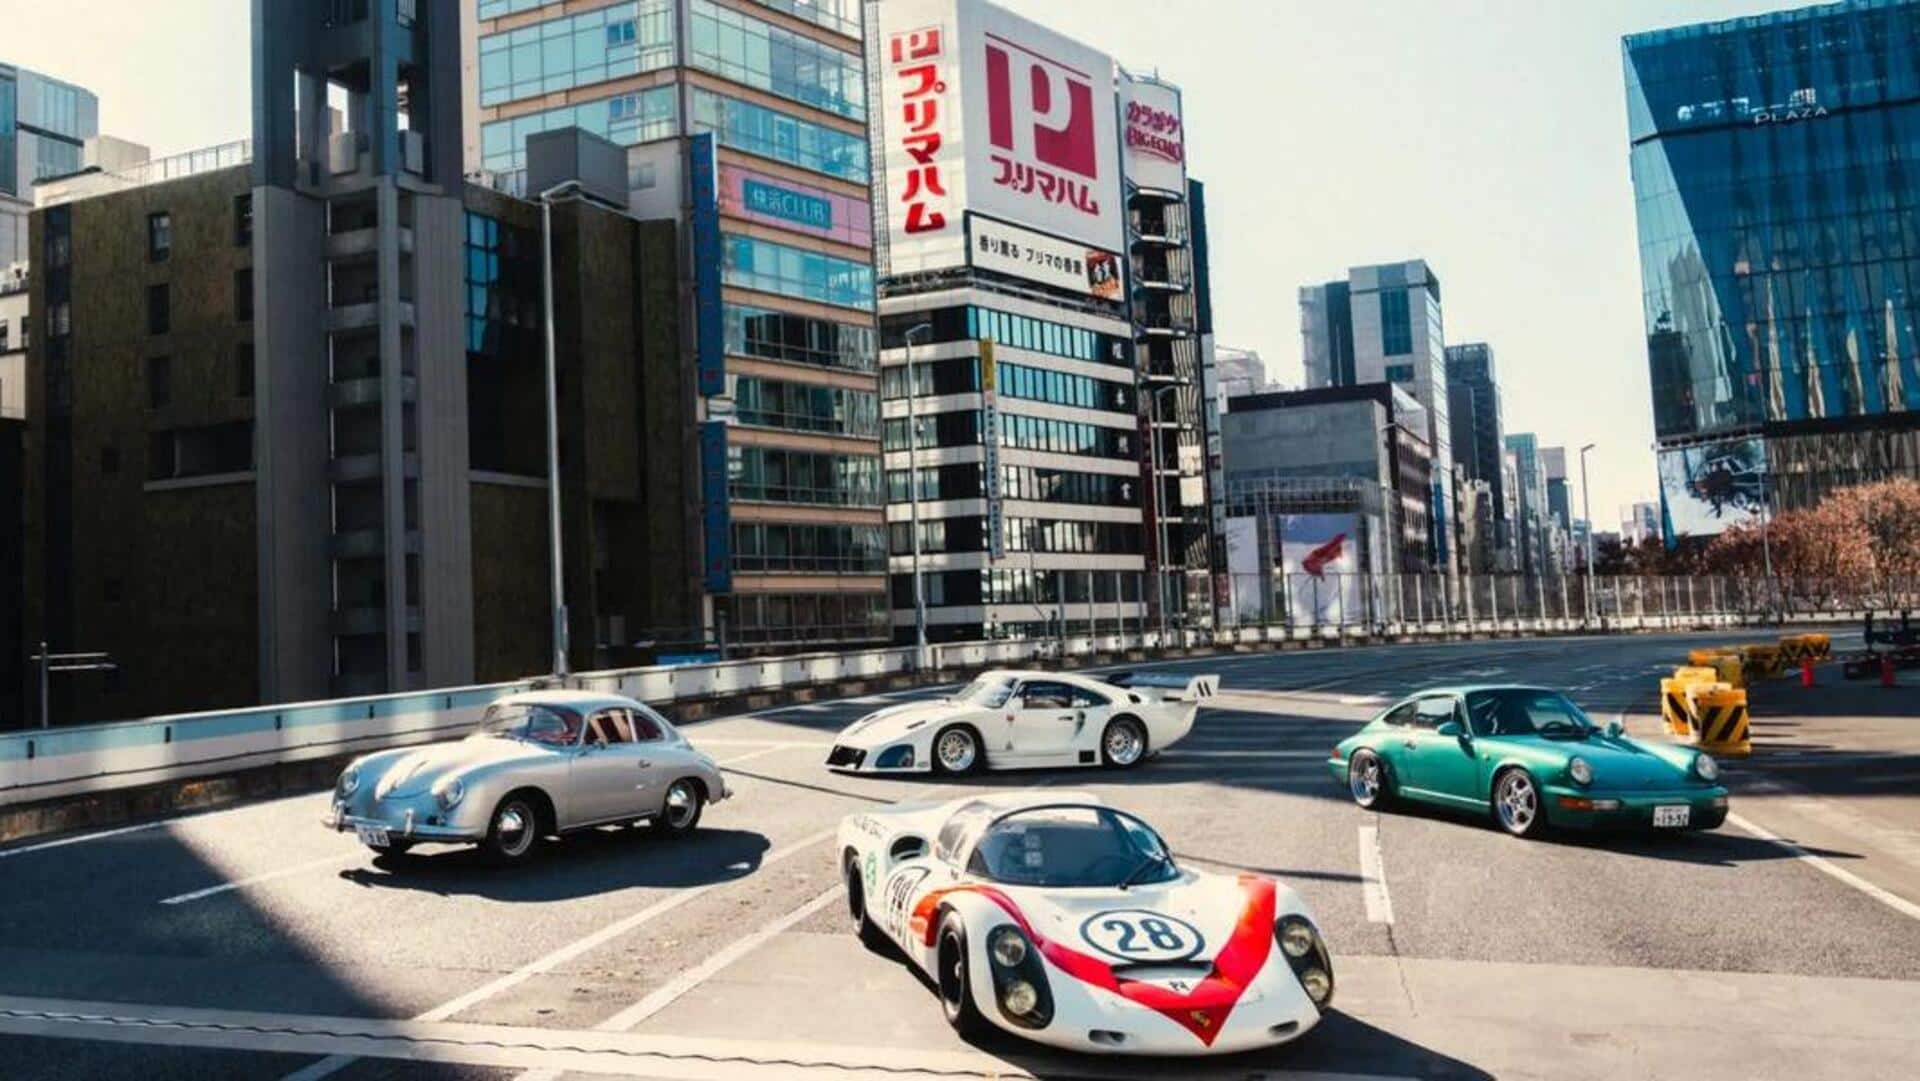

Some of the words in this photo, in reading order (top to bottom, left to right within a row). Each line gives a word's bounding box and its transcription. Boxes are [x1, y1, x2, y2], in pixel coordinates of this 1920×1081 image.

[1127, 100, 1178, 135] カラオケ
[1754, 106, 1828, 125] PLAZA
[898, 64, 946, 234] プリマハム
[990, 155, 1099, 216] プリマハム
[1103, 918, 1184, 952] 28
